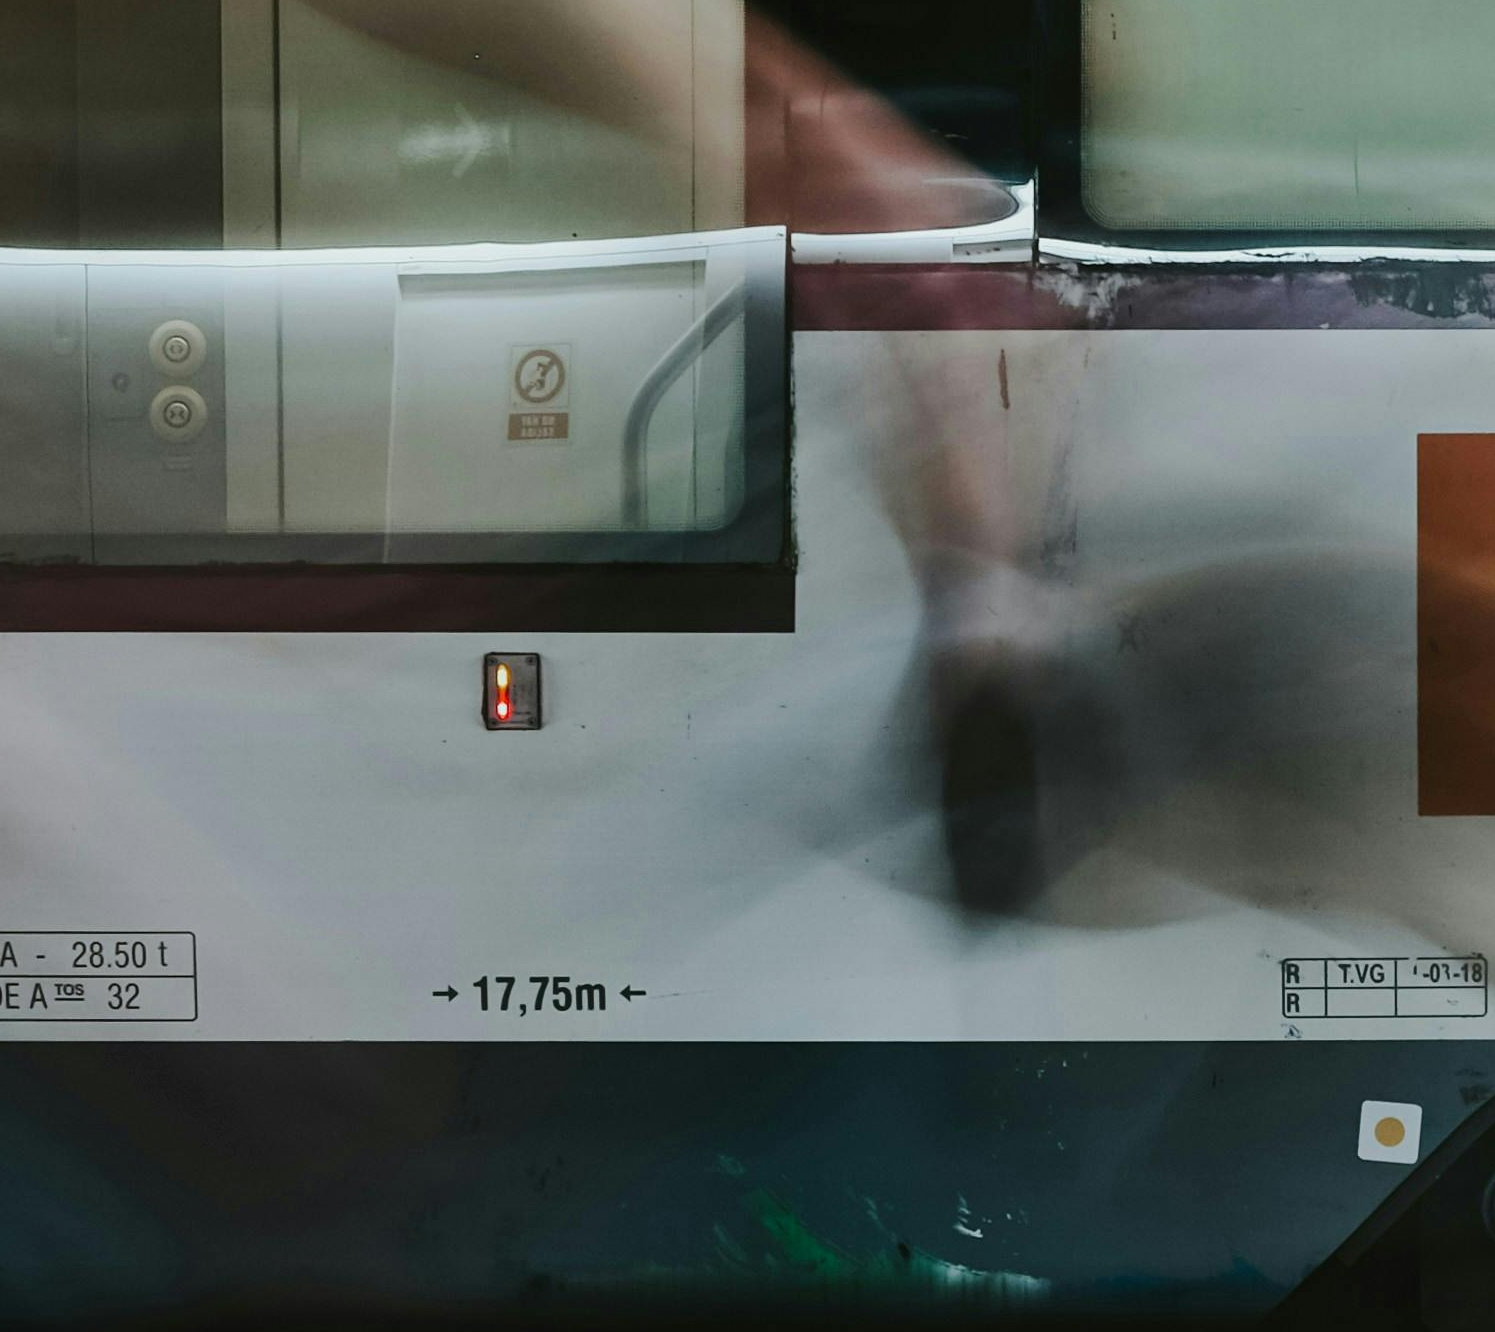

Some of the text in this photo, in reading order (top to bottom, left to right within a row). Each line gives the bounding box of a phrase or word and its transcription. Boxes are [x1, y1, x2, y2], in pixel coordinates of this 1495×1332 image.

[72, 940, 147, 969] 28.50
[158, 941, 168, 967] t
[1285, 963, 1301, 984] R
[1337, 963, 1385, 984] T.VG
[107, 982, 141, 1010] 32
[472, 975, 607, 1017] 17,75m
[1285, 993, 1301, 1013] R
